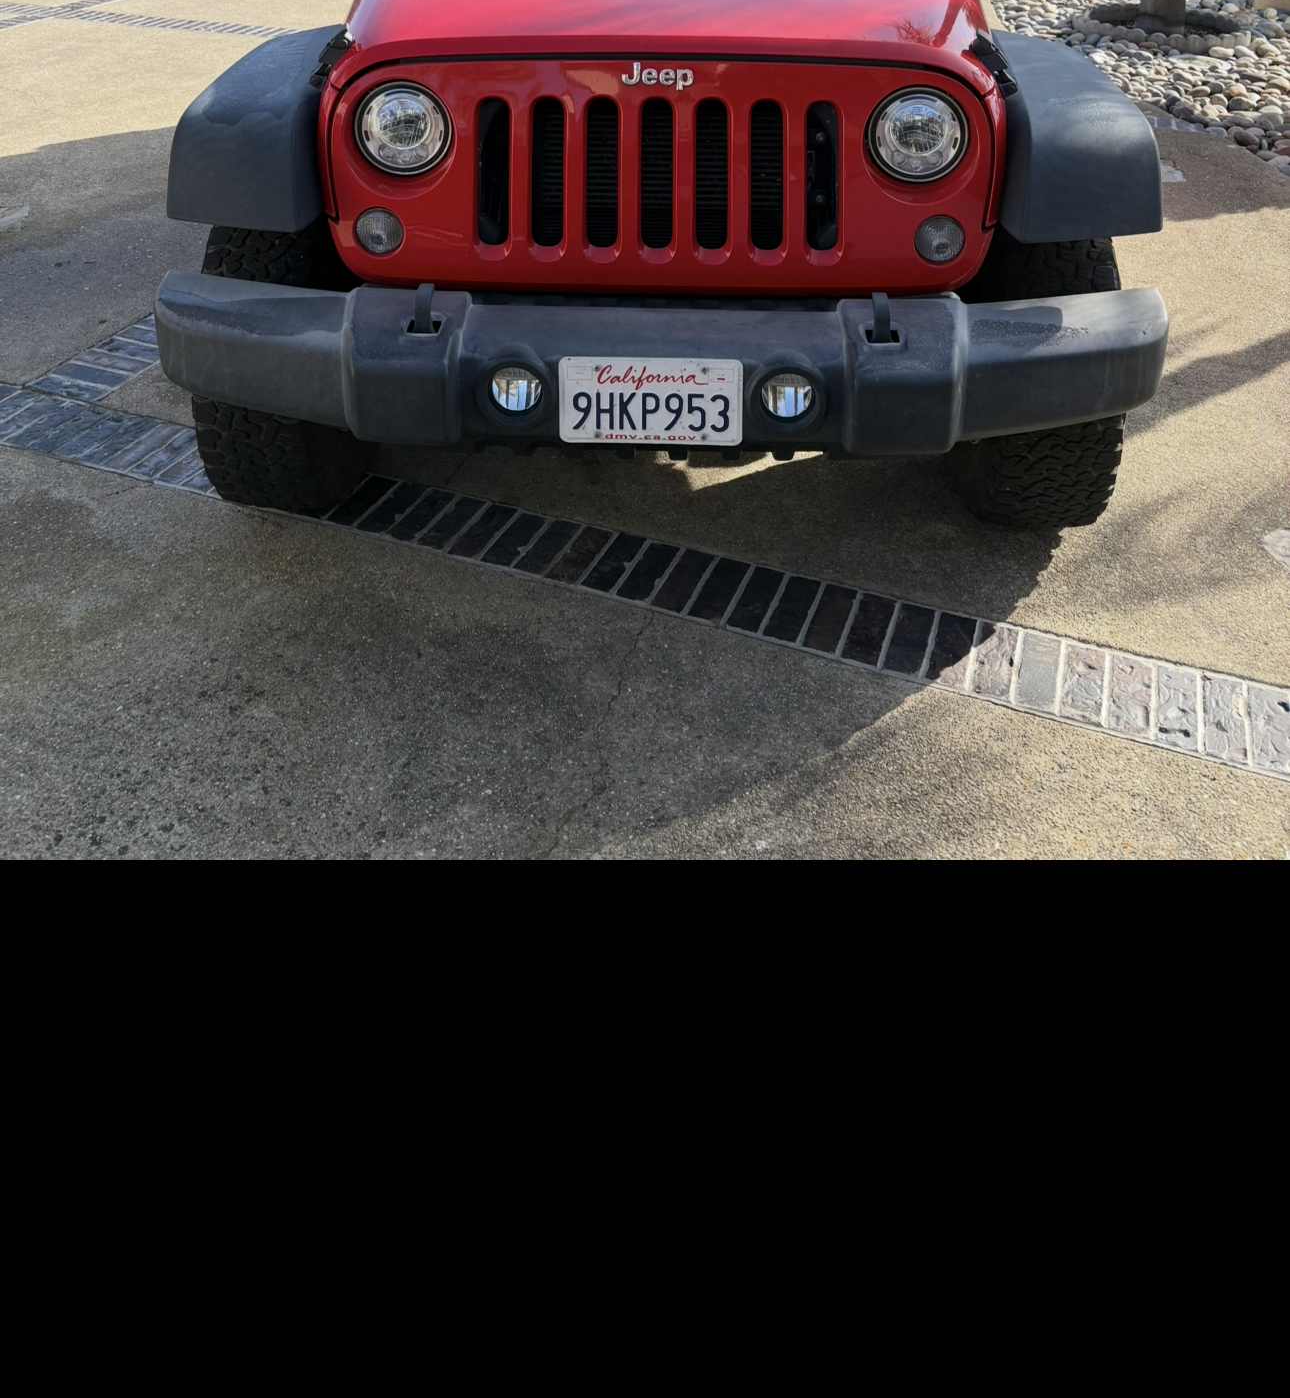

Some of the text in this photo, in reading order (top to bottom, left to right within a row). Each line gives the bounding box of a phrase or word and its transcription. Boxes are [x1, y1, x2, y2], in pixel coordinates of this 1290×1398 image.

[621, 61, 694, 91] Jeep
[597, 364, 709, 391] California
[572, 391, 730, 433] 9HKP953
[605, 433, 697, 441] dmv.ca.gov
